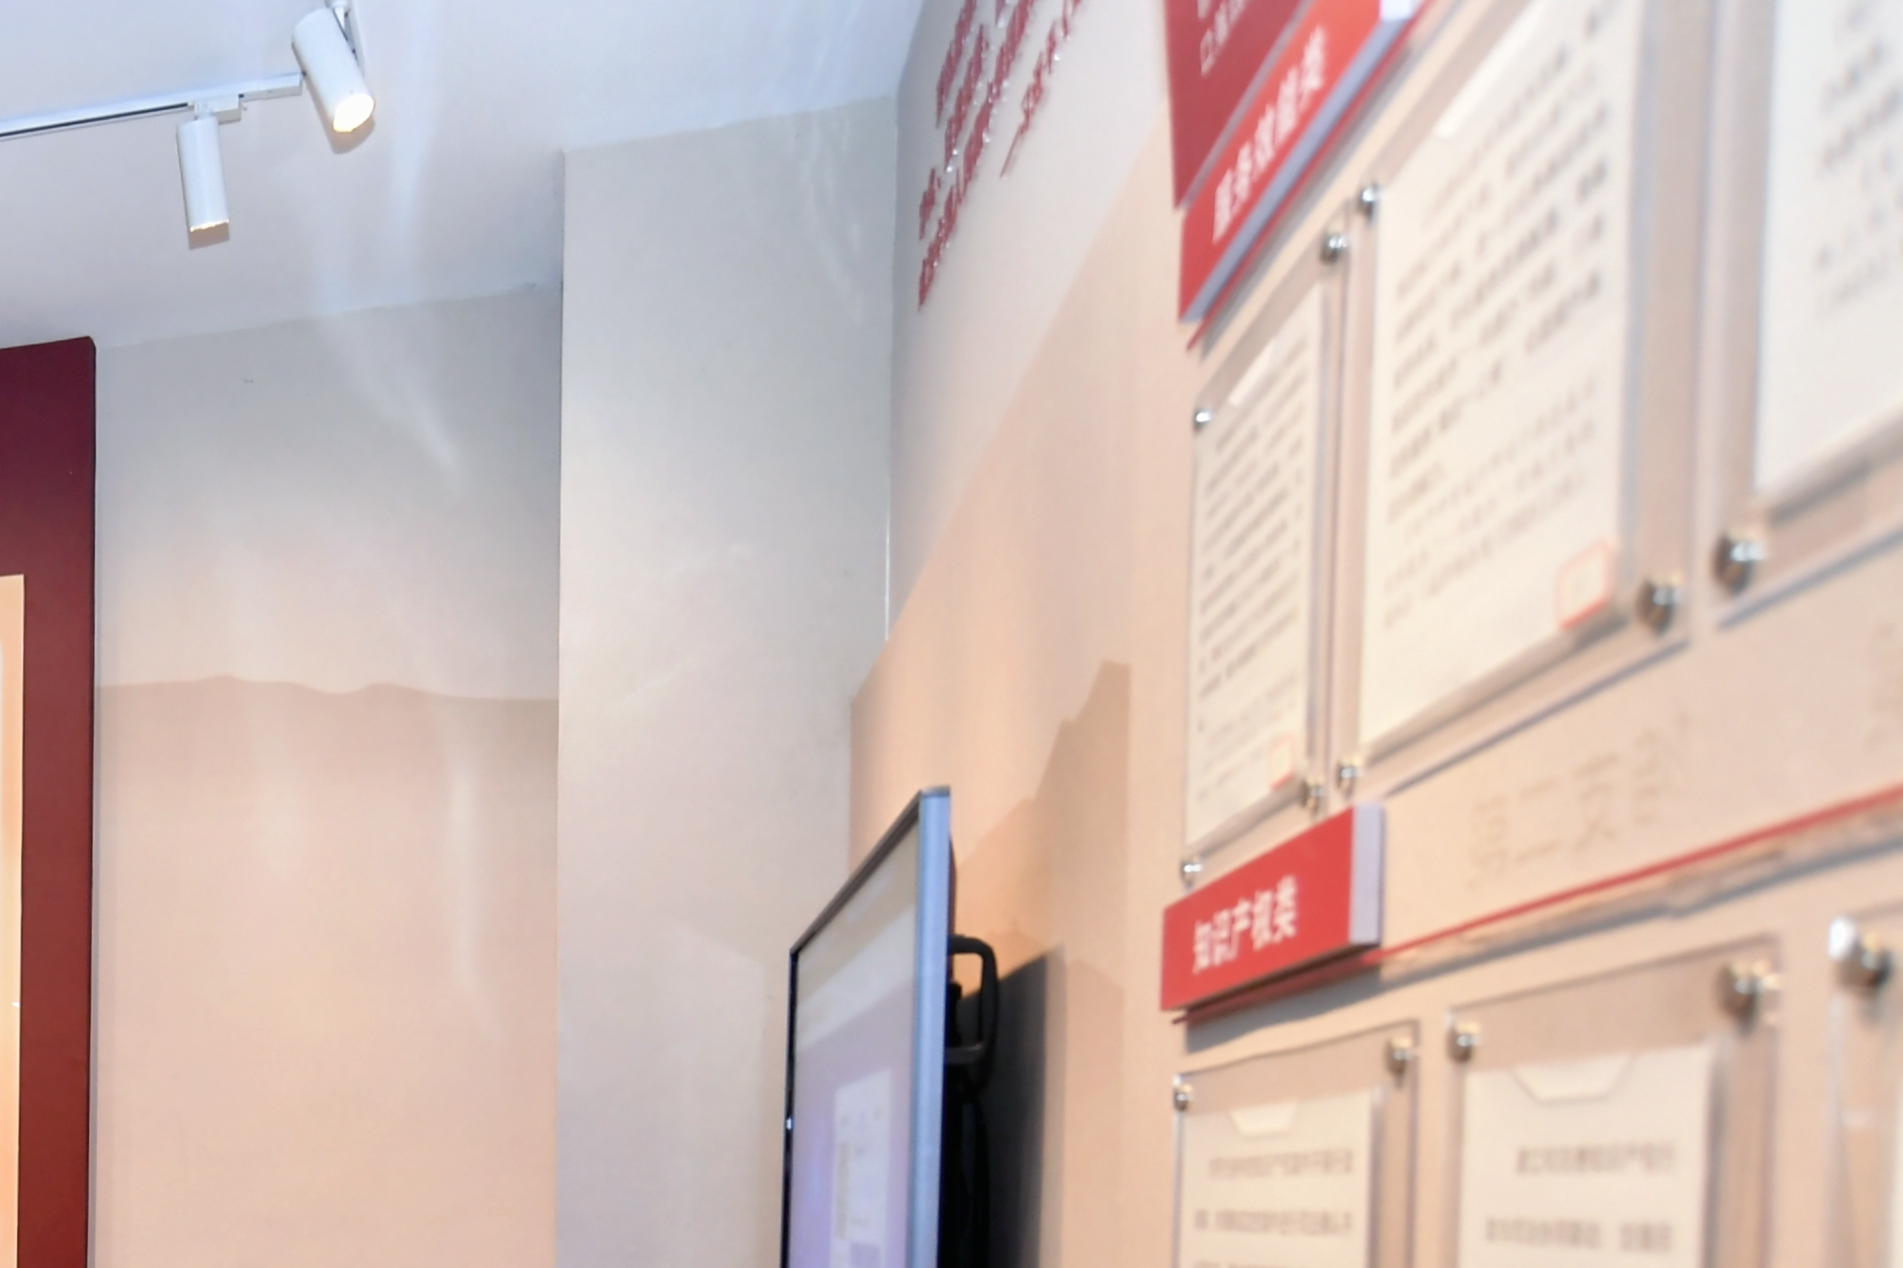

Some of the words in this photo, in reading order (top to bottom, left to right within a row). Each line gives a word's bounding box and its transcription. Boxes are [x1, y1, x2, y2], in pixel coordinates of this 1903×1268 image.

[1191, 874, 1298, 977] 知识产权类
